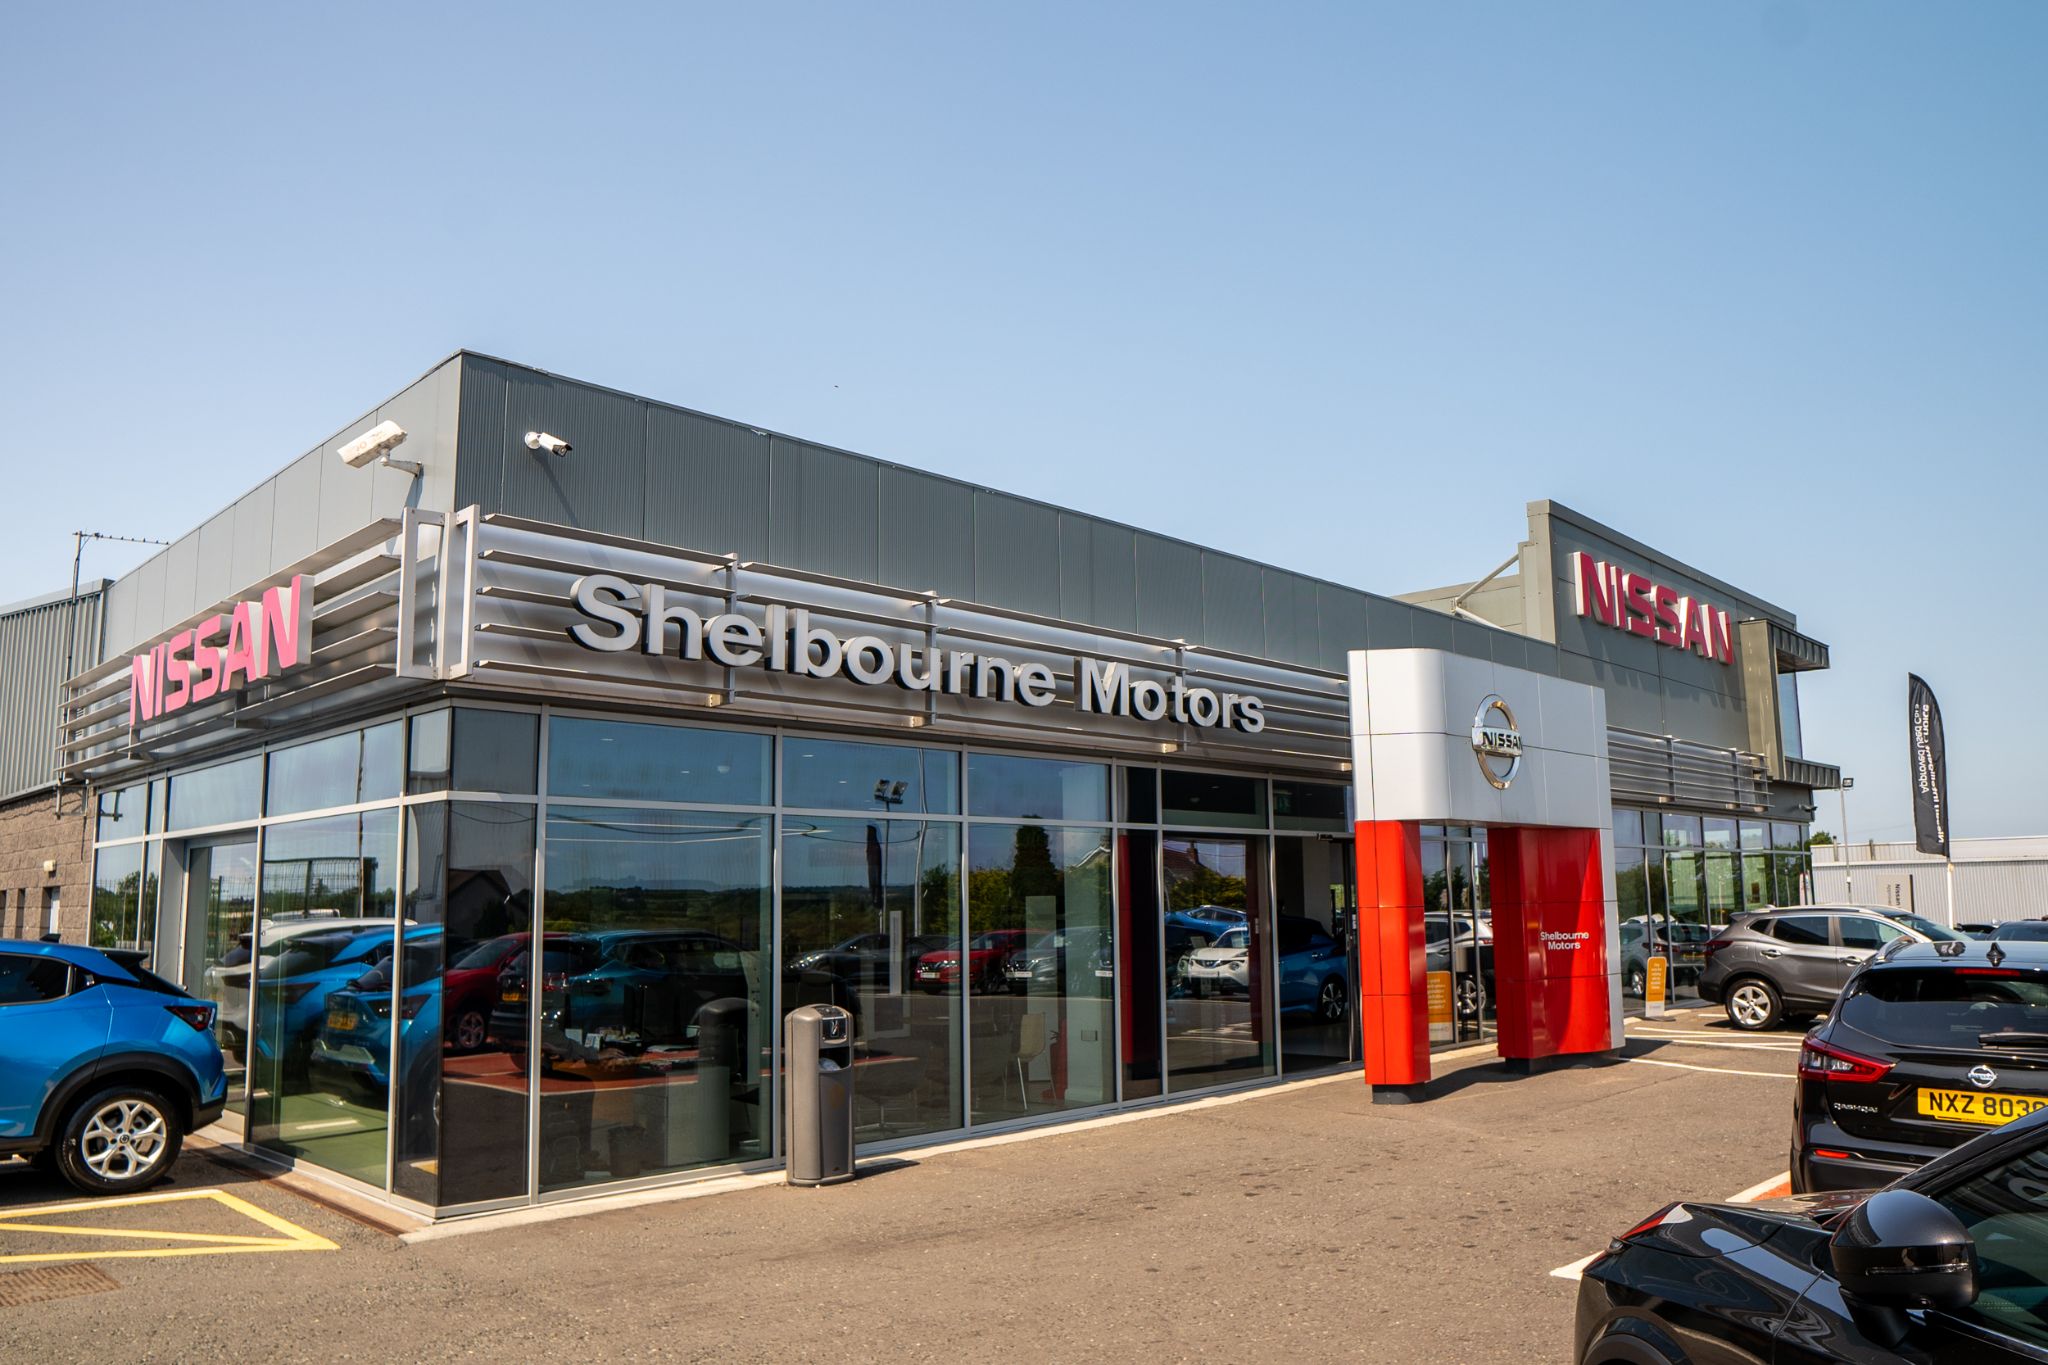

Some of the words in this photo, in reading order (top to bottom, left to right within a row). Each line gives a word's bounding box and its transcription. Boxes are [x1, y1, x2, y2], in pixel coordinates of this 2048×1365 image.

[1574, 551, 1734, 665] NISSAN
[129, 574, 313, 728] NISSAN
[563, 573, 1057, 708] Shelbourne
[1074, 656, 1267, 734] Motors
[1540, 931, 1590, 941] Shelbourne
[1547, 941, 1581, 950] Motors
[1929, 1091, 1975, 1116] NXZ
